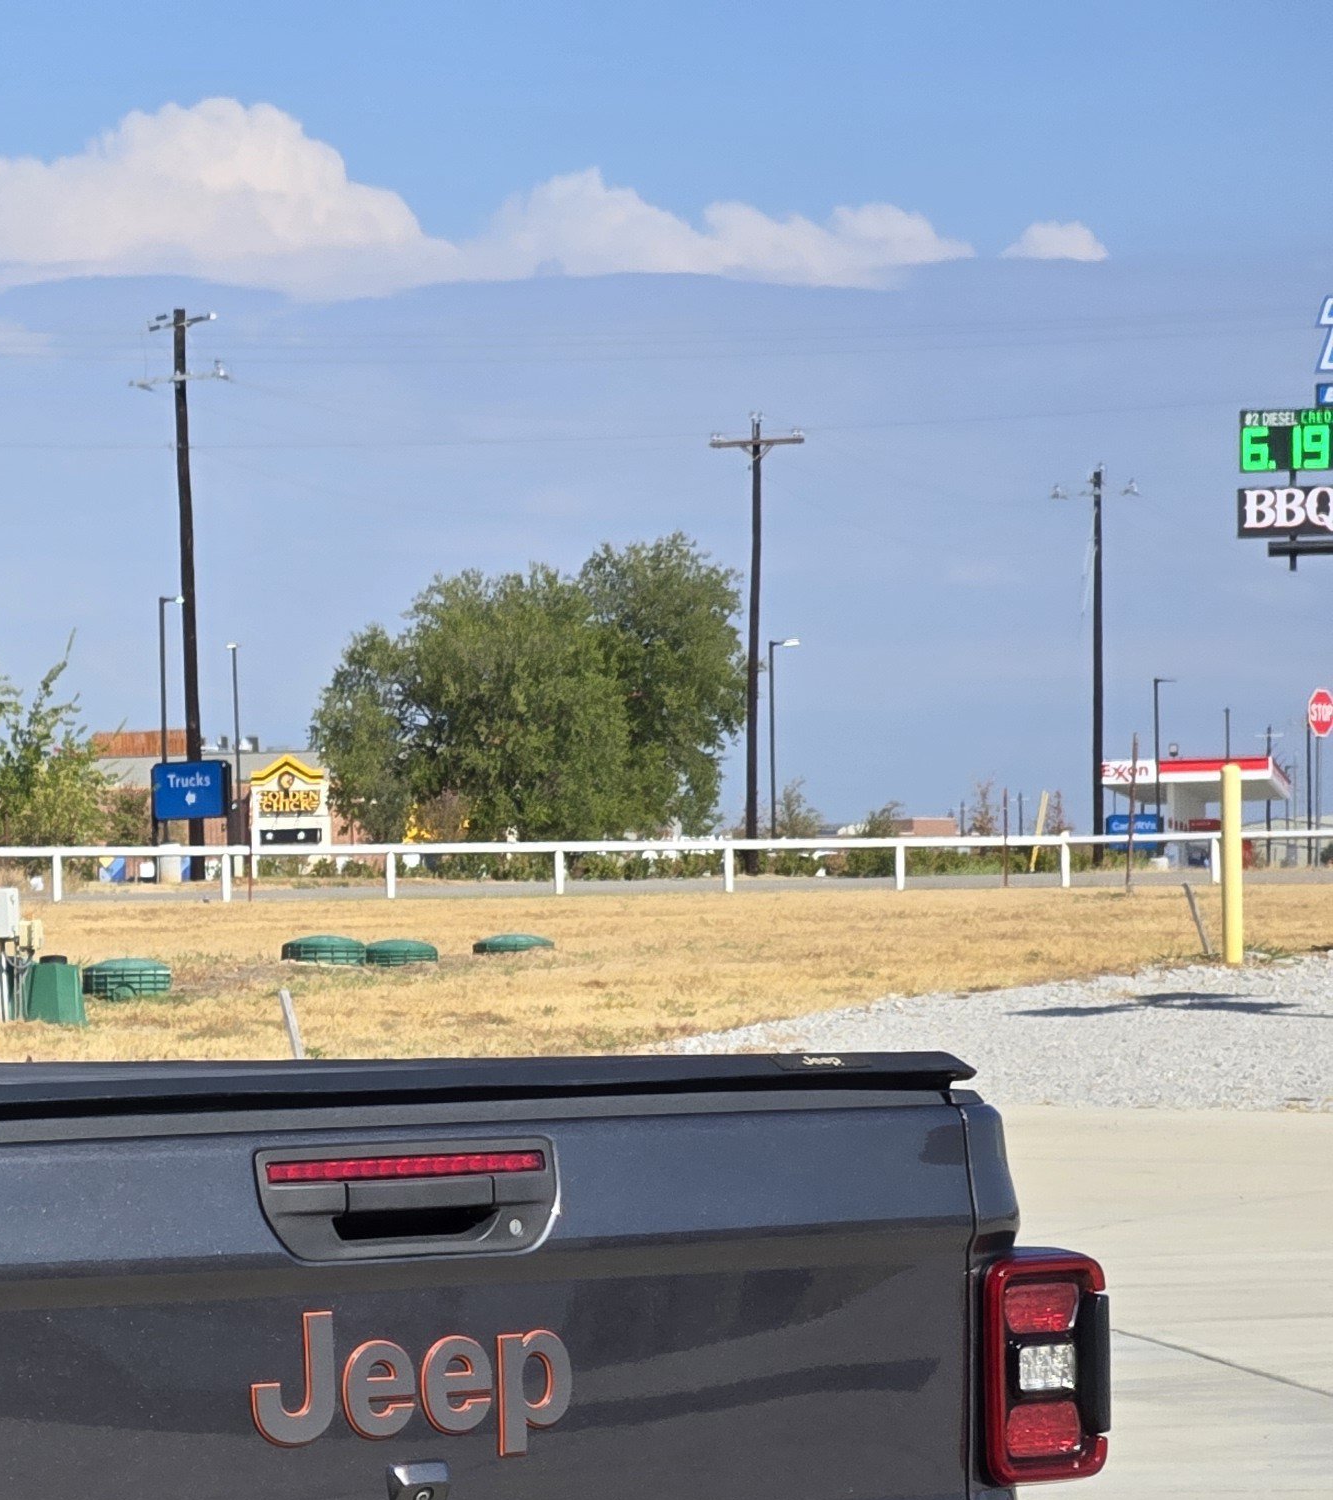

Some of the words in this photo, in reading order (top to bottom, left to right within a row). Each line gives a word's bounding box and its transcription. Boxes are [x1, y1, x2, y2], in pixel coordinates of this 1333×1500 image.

[1262, 412, 1297, 426] DIESEL
[1243, 487, 1333, 531] BBQ
[1310, 704, 1333, 721] STOP
[166, 771, 211, 788] Trucks
[1100, 764, 1149, 782] Exxon
[257, 790, 319, 801] GOLDEN
[262, 801, 313, 812] CHICK
[250, 1308, 573, 1457] Jeep
